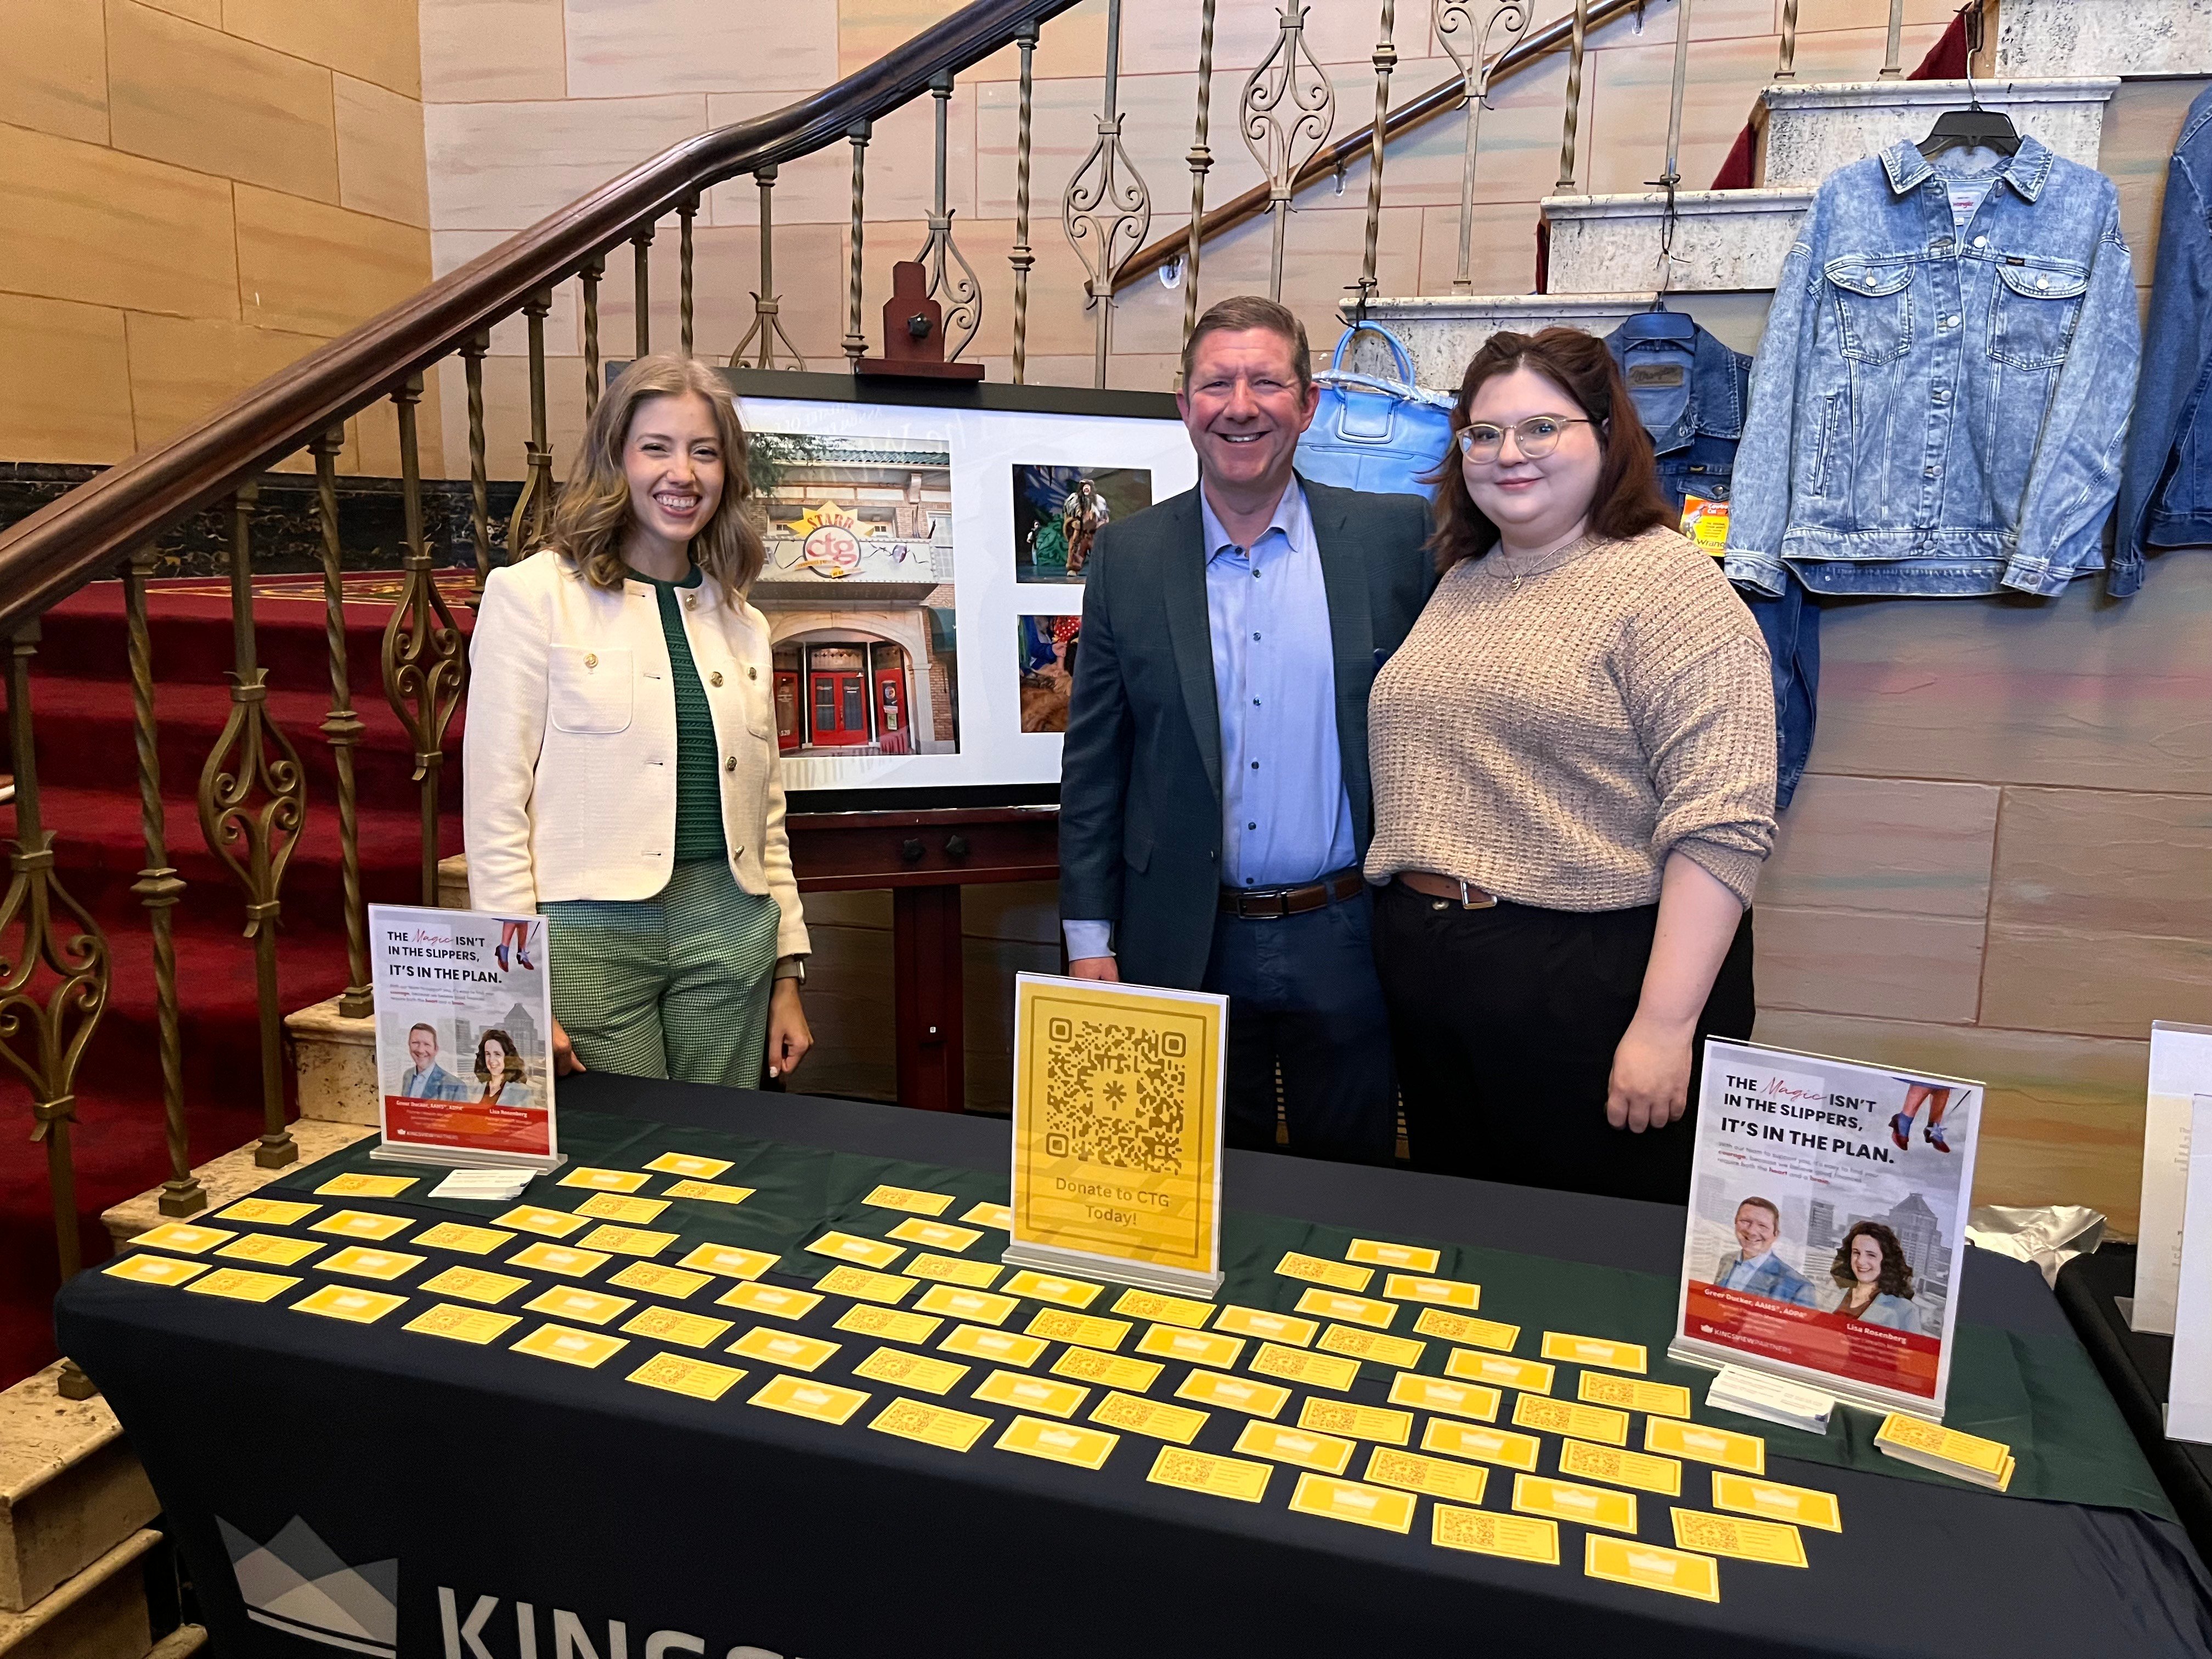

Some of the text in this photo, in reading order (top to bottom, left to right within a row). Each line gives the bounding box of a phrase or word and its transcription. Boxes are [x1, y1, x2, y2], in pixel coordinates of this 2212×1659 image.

[806, 532, 858, 565] ctg
[387, 928, 485, 947] THE Magic ISN'T
[388, 945, 480, 962] IN THE SLIPPERS,
[390, 964, 502, 984] IT'S IN THE PLAN.
[1726, 1075, 1877, 1113] THE Magic ISN'T
[1724, 1093, 1863, 1132] IN THE SLIPPERS,
[1721, 1117, 1758, 1137] IT'S
[1763, 1125, 1784, 1142] IN
[1789, 1130, 1828, 1151] THE
[1832, 1139, 1894, 1164] PLAN.
[1056, 1177, 1169, 1207] Donate to CTG
[1086, 1205, 1137, 1227] Today!
[1847, 1323, 1907, 1345] Lisa Rosenberg
